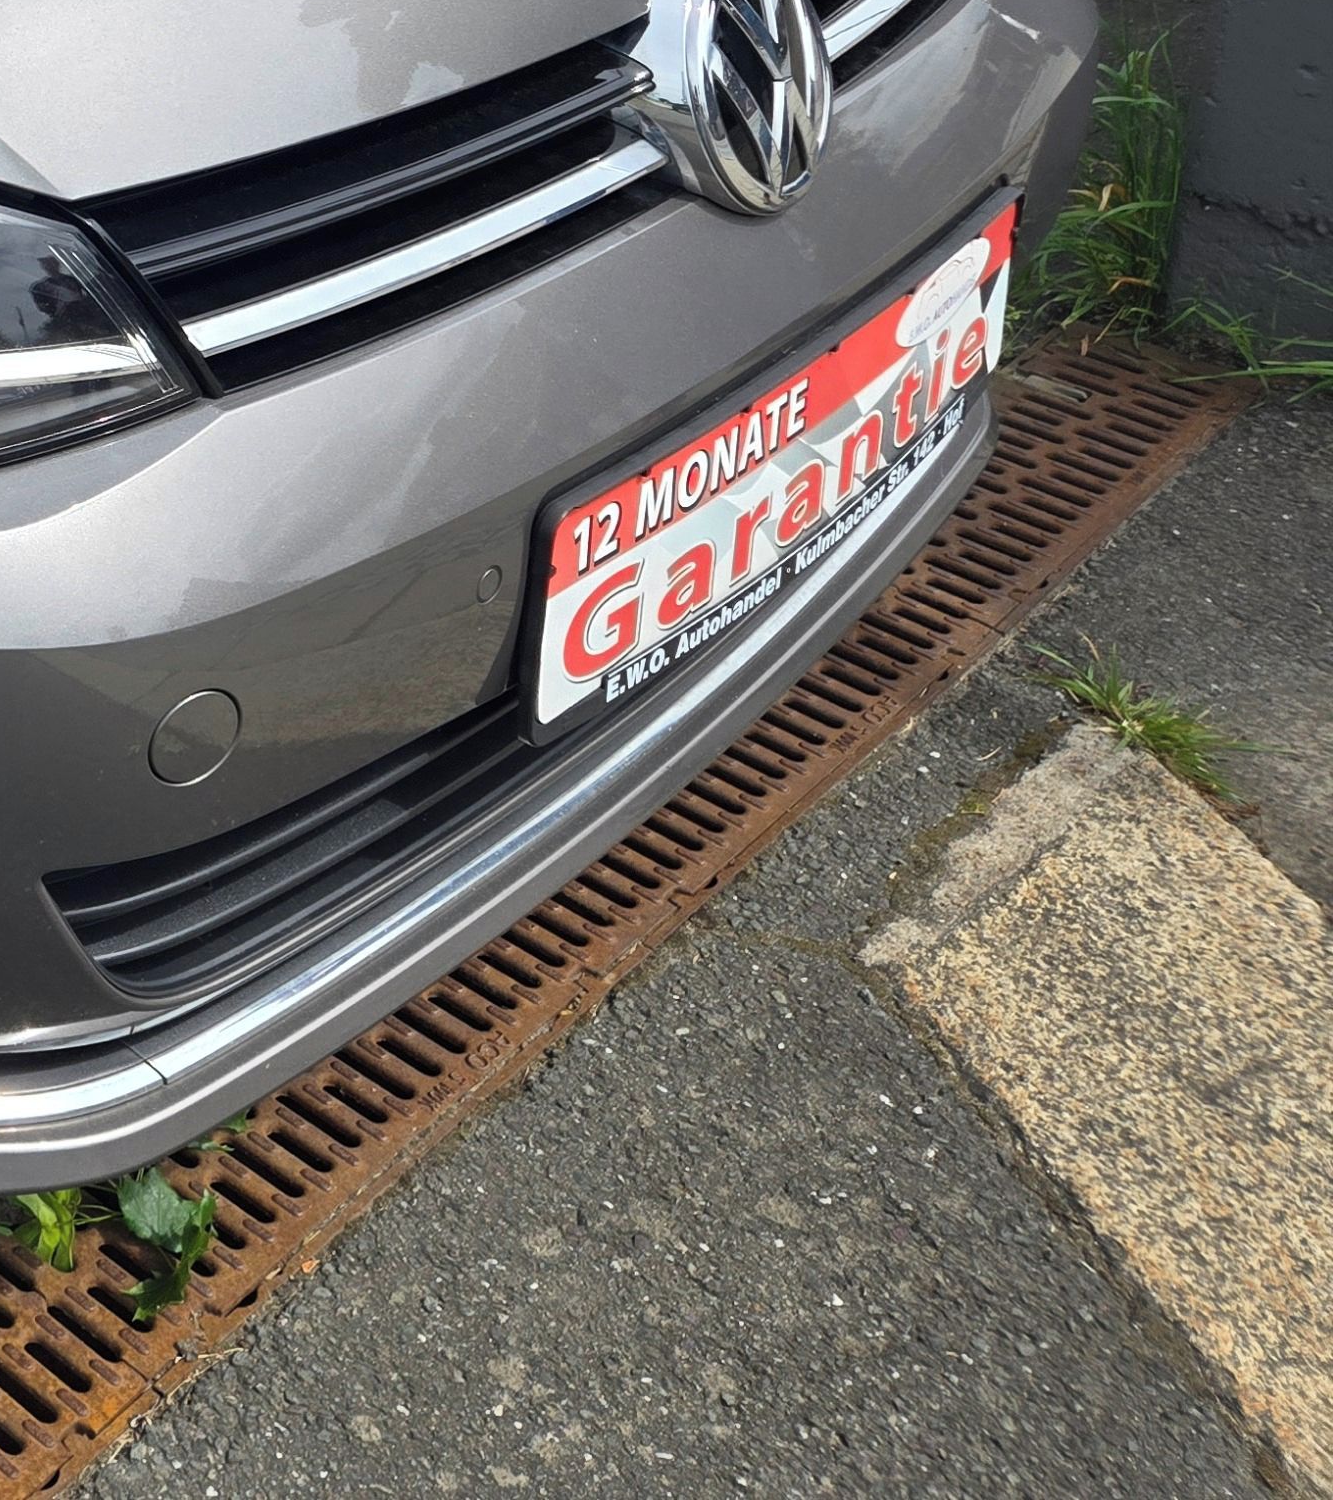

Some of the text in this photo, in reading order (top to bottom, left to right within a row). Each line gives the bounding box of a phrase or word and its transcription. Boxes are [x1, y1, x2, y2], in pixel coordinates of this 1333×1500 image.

[561, 312, 989, 684] Garantie
[573, 378, 810, 574] 12 MONATE
[605, 397, 966, 703] E.W.O. Autohandel Kulmbacher Str. 142 Hof
